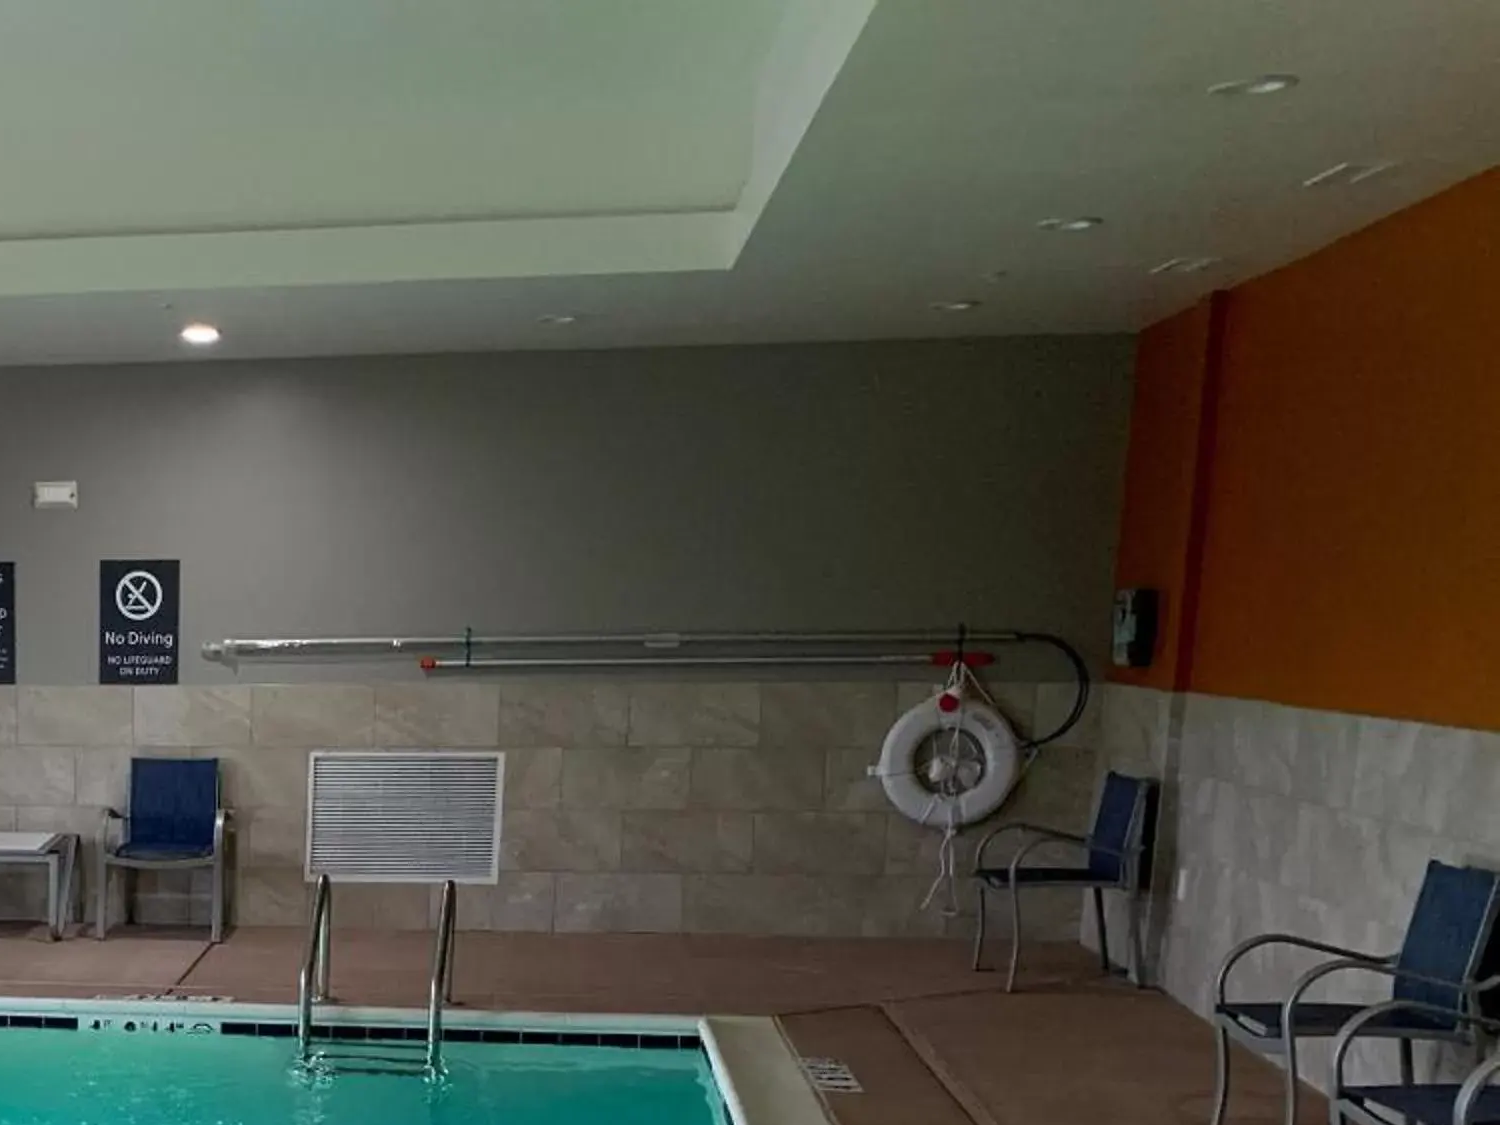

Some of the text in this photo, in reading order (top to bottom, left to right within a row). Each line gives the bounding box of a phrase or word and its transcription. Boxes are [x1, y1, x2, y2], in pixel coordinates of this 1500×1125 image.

[105, 631, 173, 649] No Diving
[107, 655, 173, 665] NO LIFEGUARD
[120, 667, 160, 676] ON DUTY
